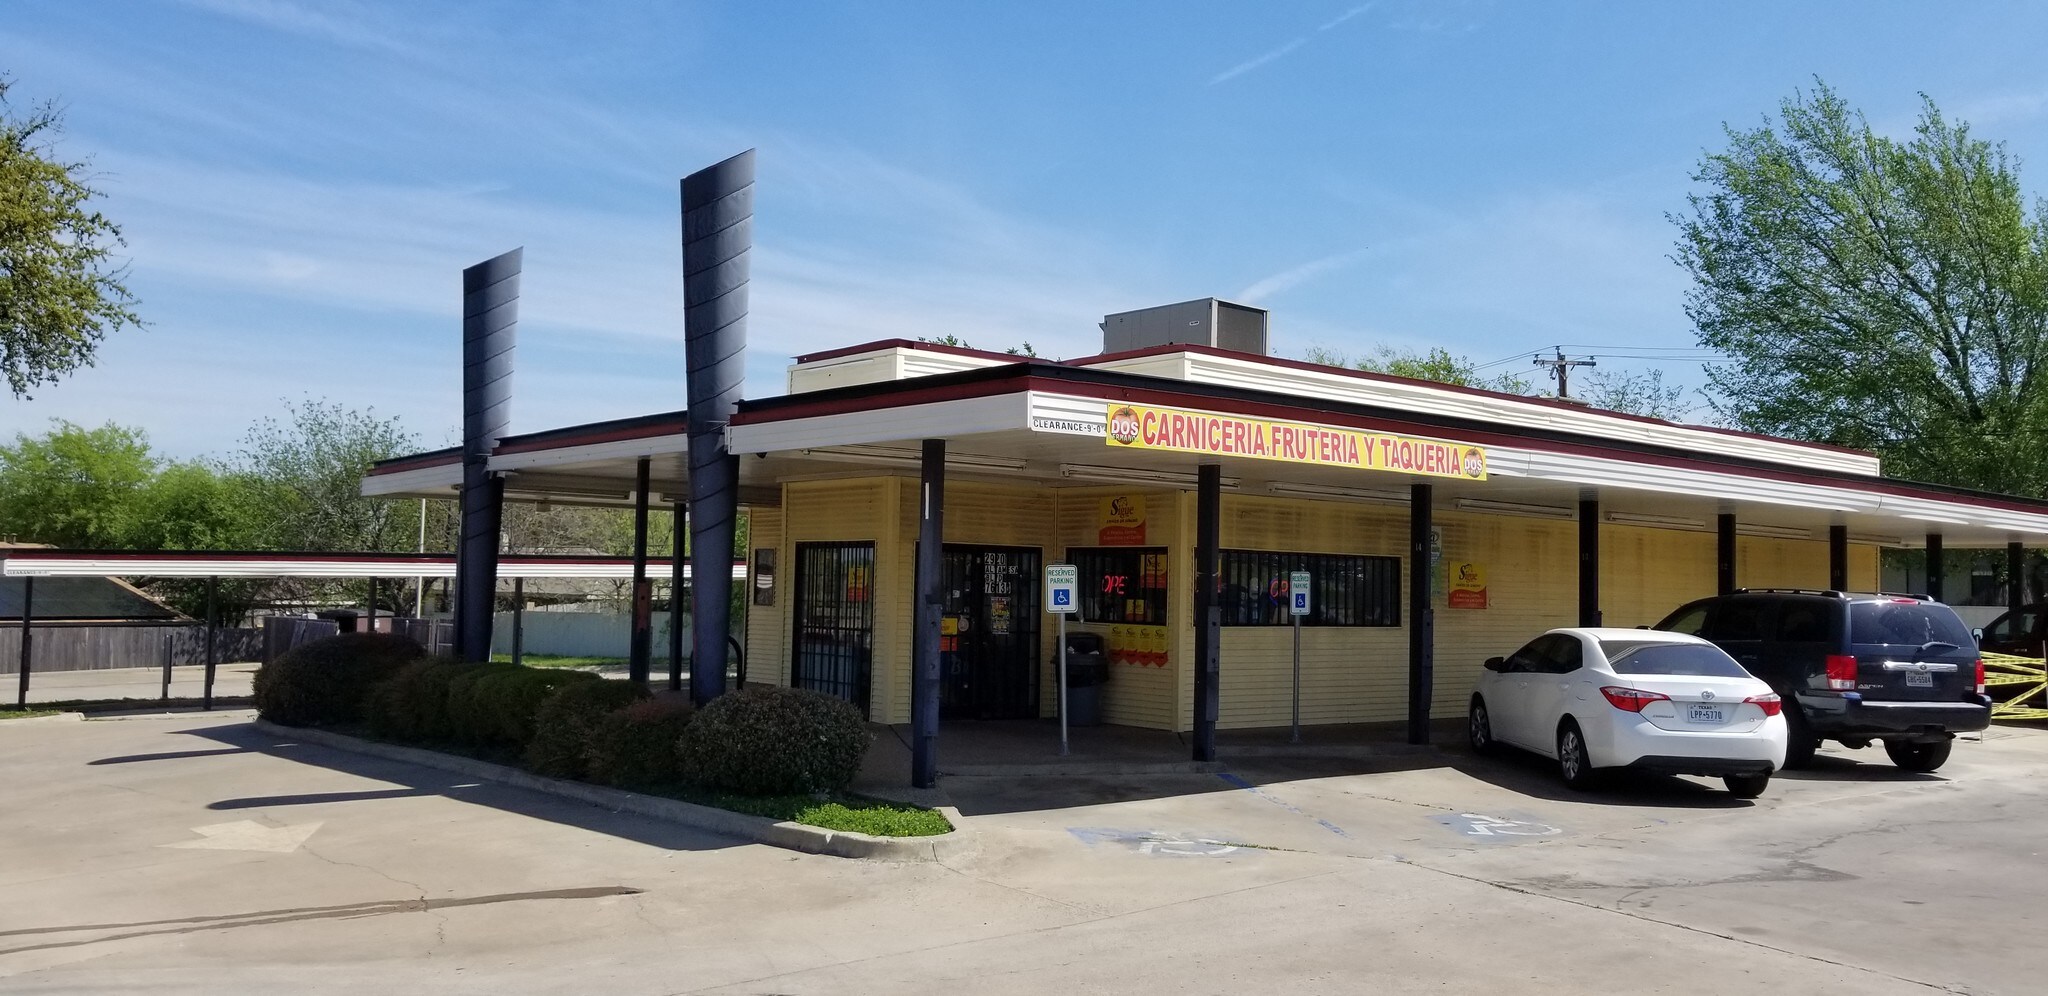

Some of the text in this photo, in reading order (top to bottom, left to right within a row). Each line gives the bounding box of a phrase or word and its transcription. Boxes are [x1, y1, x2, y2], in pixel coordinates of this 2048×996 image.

[1111, 418, 1139, 436] DOS
[1271, 426, 1359, 465] FRUTERIA
[1363, 436, 1375, 466] Y
[1380, 438, 1461, 476] TAQUERIA
[1464, 458, 1483, 472] DOS
